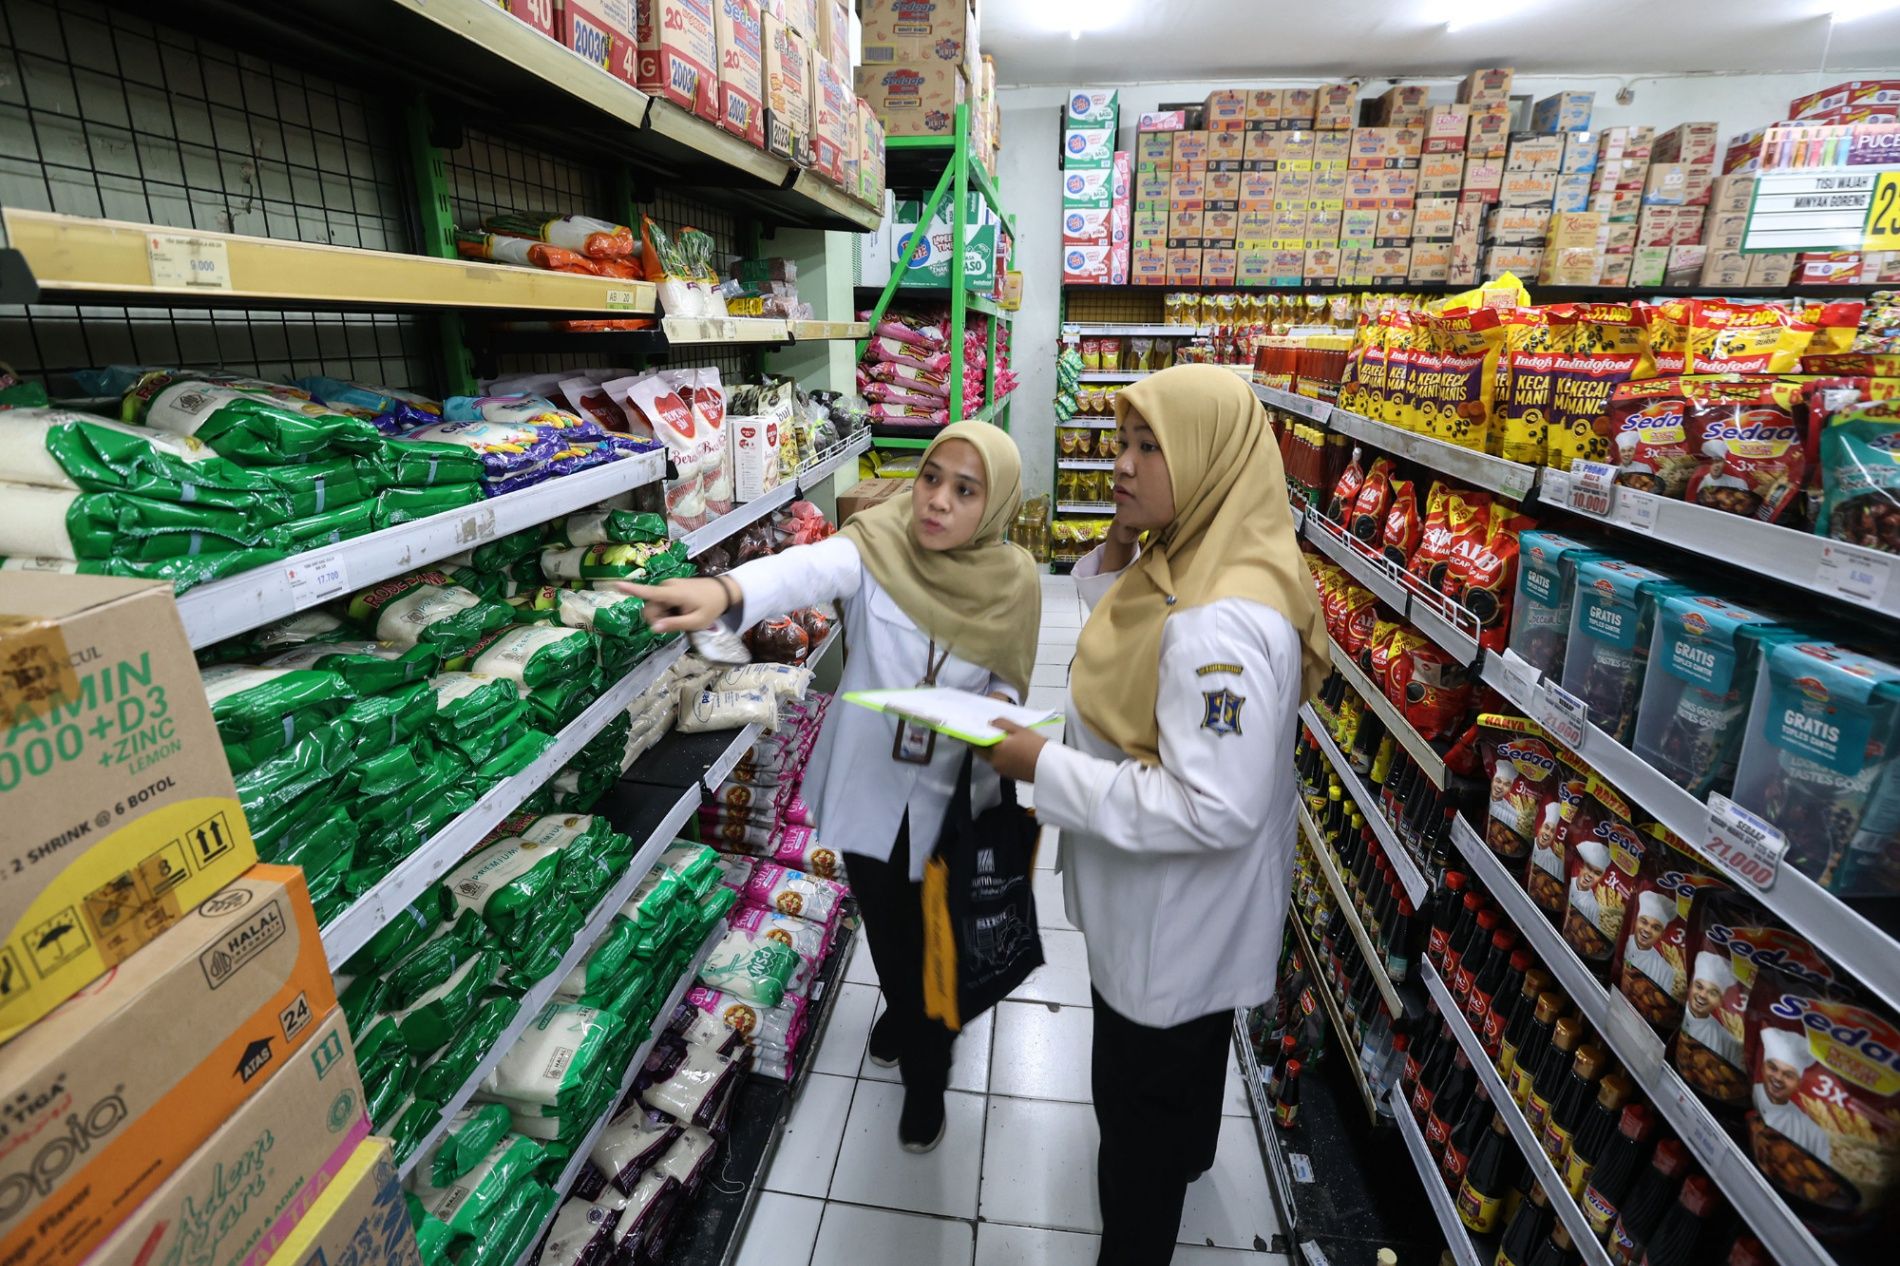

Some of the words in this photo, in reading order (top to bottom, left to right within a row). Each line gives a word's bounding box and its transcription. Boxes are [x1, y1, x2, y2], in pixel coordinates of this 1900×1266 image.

[1816, 178, 1836, 189] TISU
[1838, 176, 1869, 188] WAJAH
[1794, 196, 1828, 208] MINYAK
[1830, 195, 1866, 206] GORENG
[1569, 358, 1634, 374] Indofood
[1693, 357, 1765, 374] Indofood
[1528, 570, 1551, 588] GRATIS
[1589, 606, 1622, 627] GRATIS
[1674, 641, 1716, 668] GRATIS
[1781, 724, 1810, 743] TOPLES
[1784, 709, 1840, 742] GRATIS
[98, 717, 175, 768] +ZINC
[128, 738, 182, 776] LEMON
[27, 820, 92, 865] SHRINK
[114, 803, 126, 817] 6
[126, 774, 176, 808] BOTOL
[471, 847, 520, 882] PREMIUM
[1705, 836, 1773, 884] 21.000
[228, 910, 279, 953] HALAL
[751, 949, 771, 976] PSM
[283, 998, 308, 1032] 24
[242, 1047, 272, 1081] ATAS
[1811, 1074, 1849, 1109] 3x
